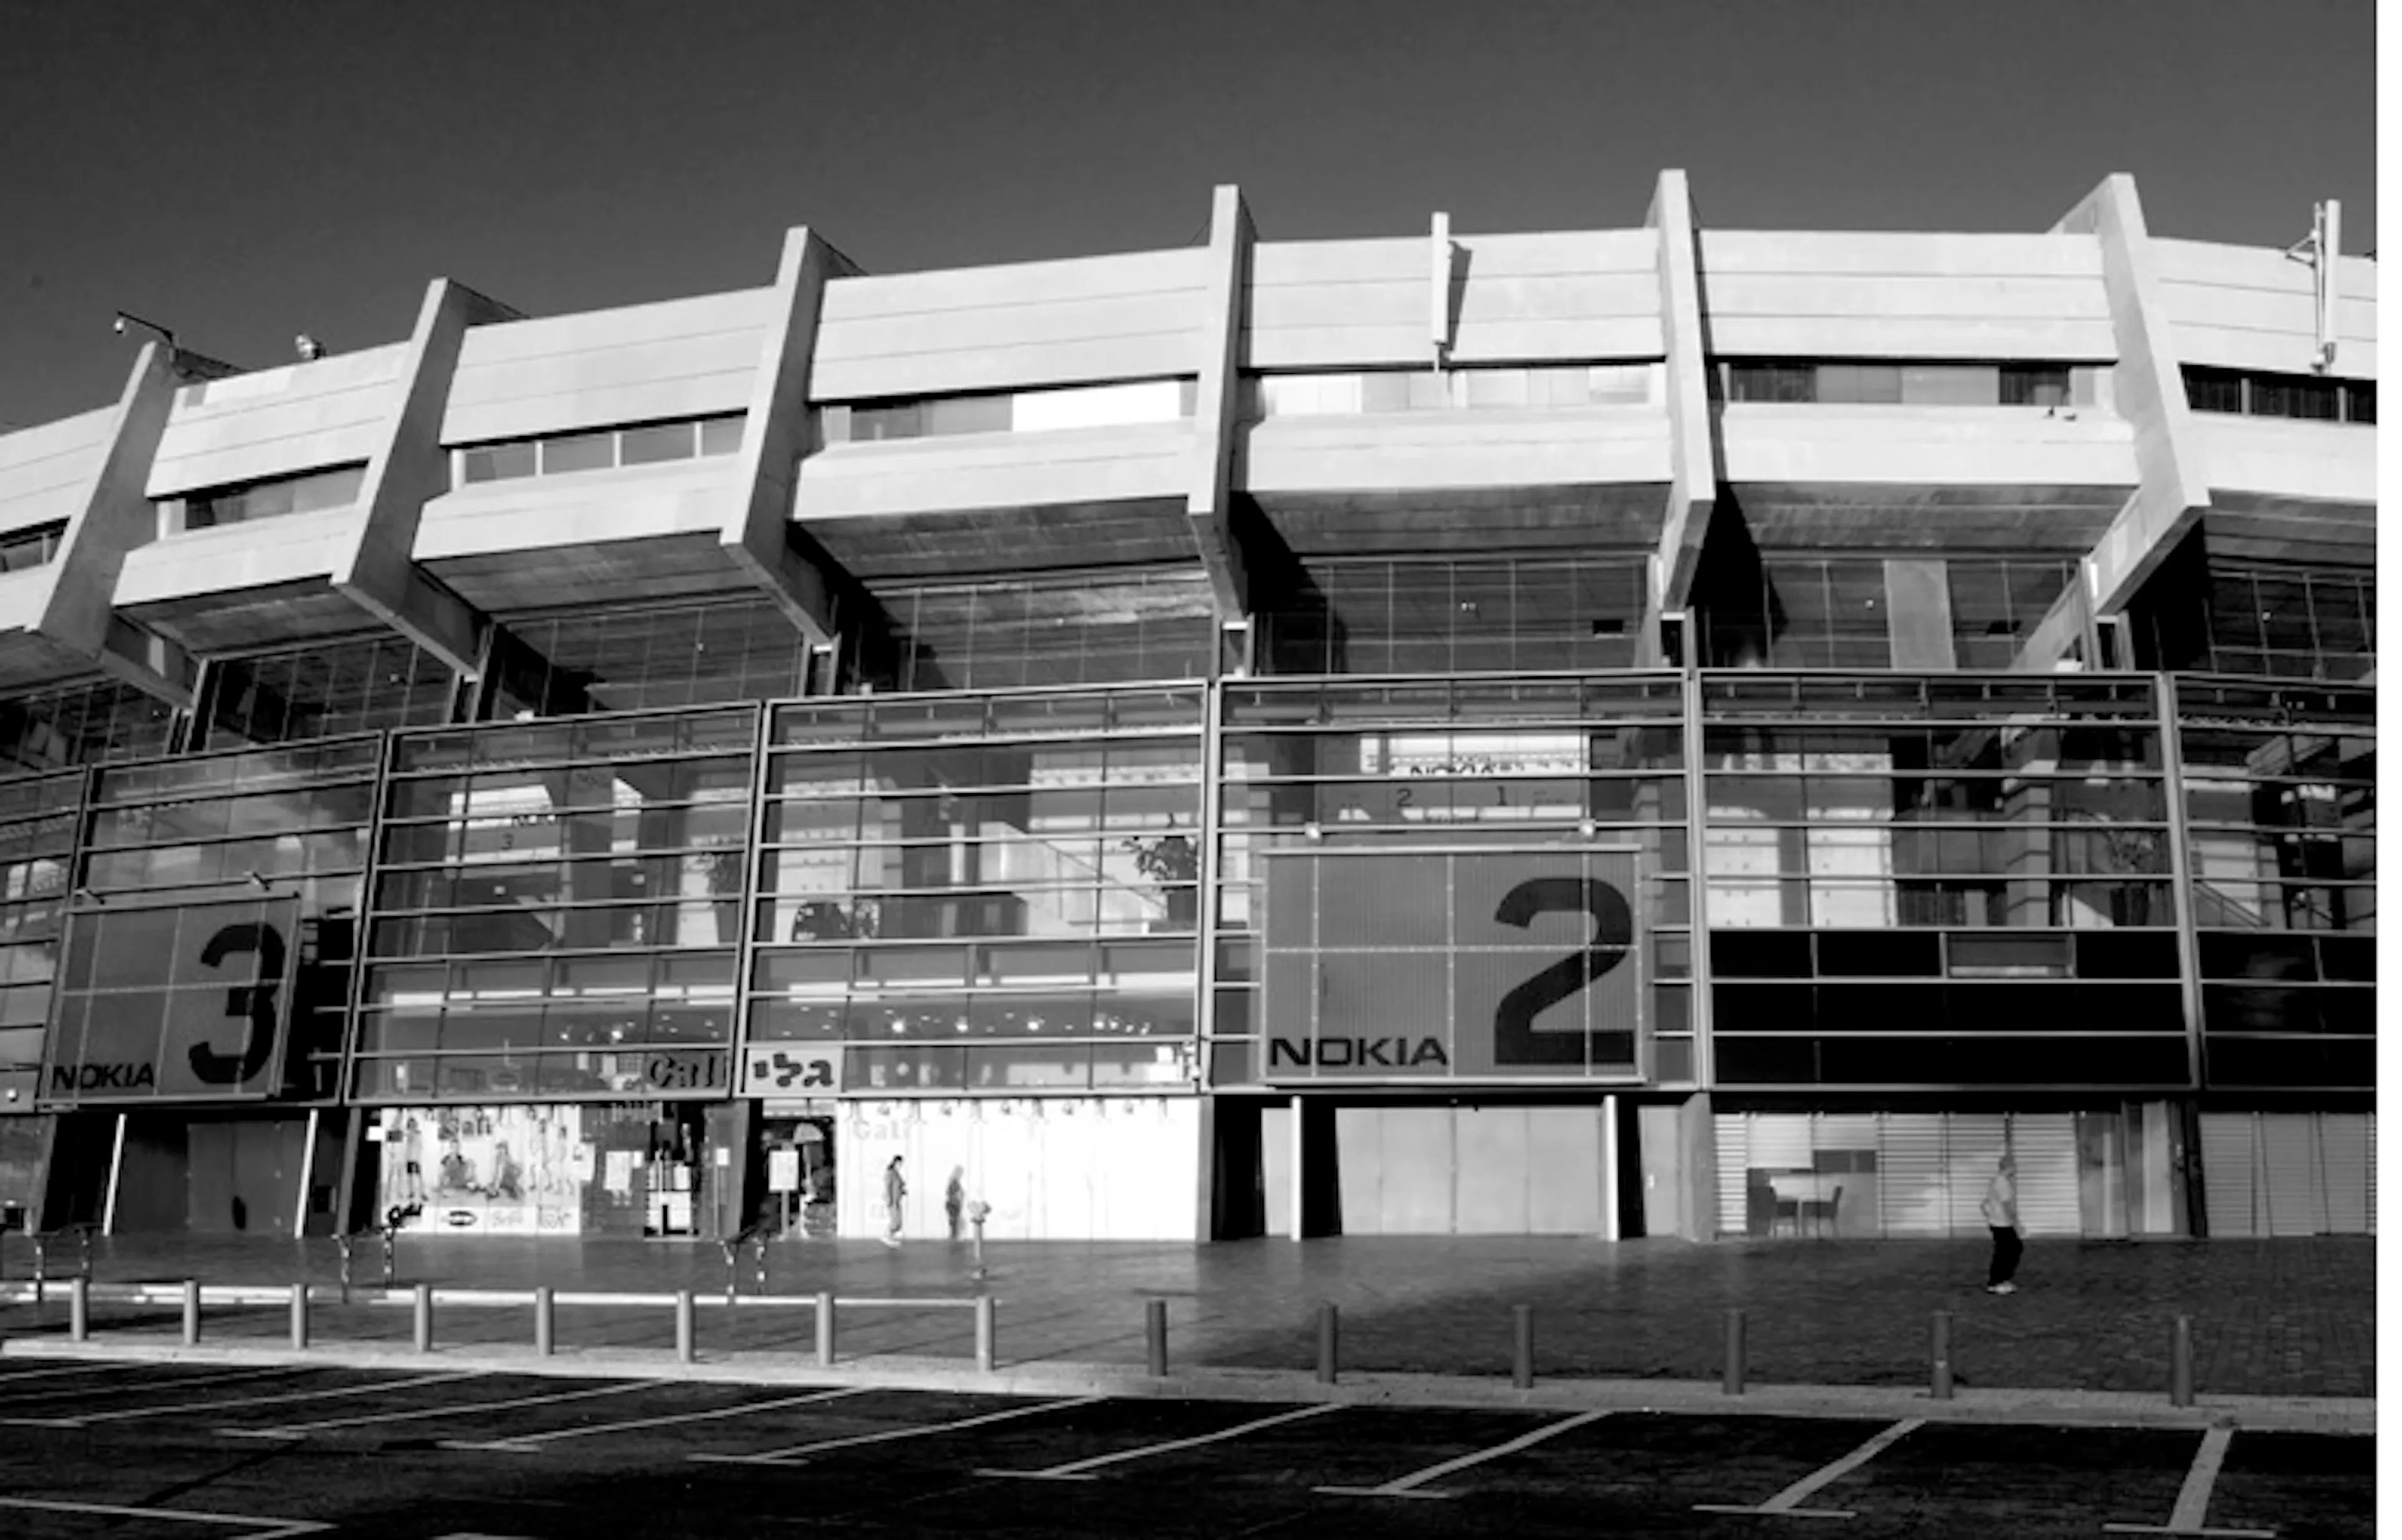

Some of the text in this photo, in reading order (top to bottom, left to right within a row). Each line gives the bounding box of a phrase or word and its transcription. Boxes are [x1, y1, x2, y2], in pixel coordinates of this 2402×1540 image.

[1397, 788, 1414, 806] 2
[1496, 785, 1508, 806] 1
[1494, 878, 1635, 1065] 2
[189, 923, 285, 1084] 3
[1269, 1037, 1449, 1066] NOKIA
[52, 1063, 155, 1090] NOKIA
[753, 1051, 834, 1088] גלי
